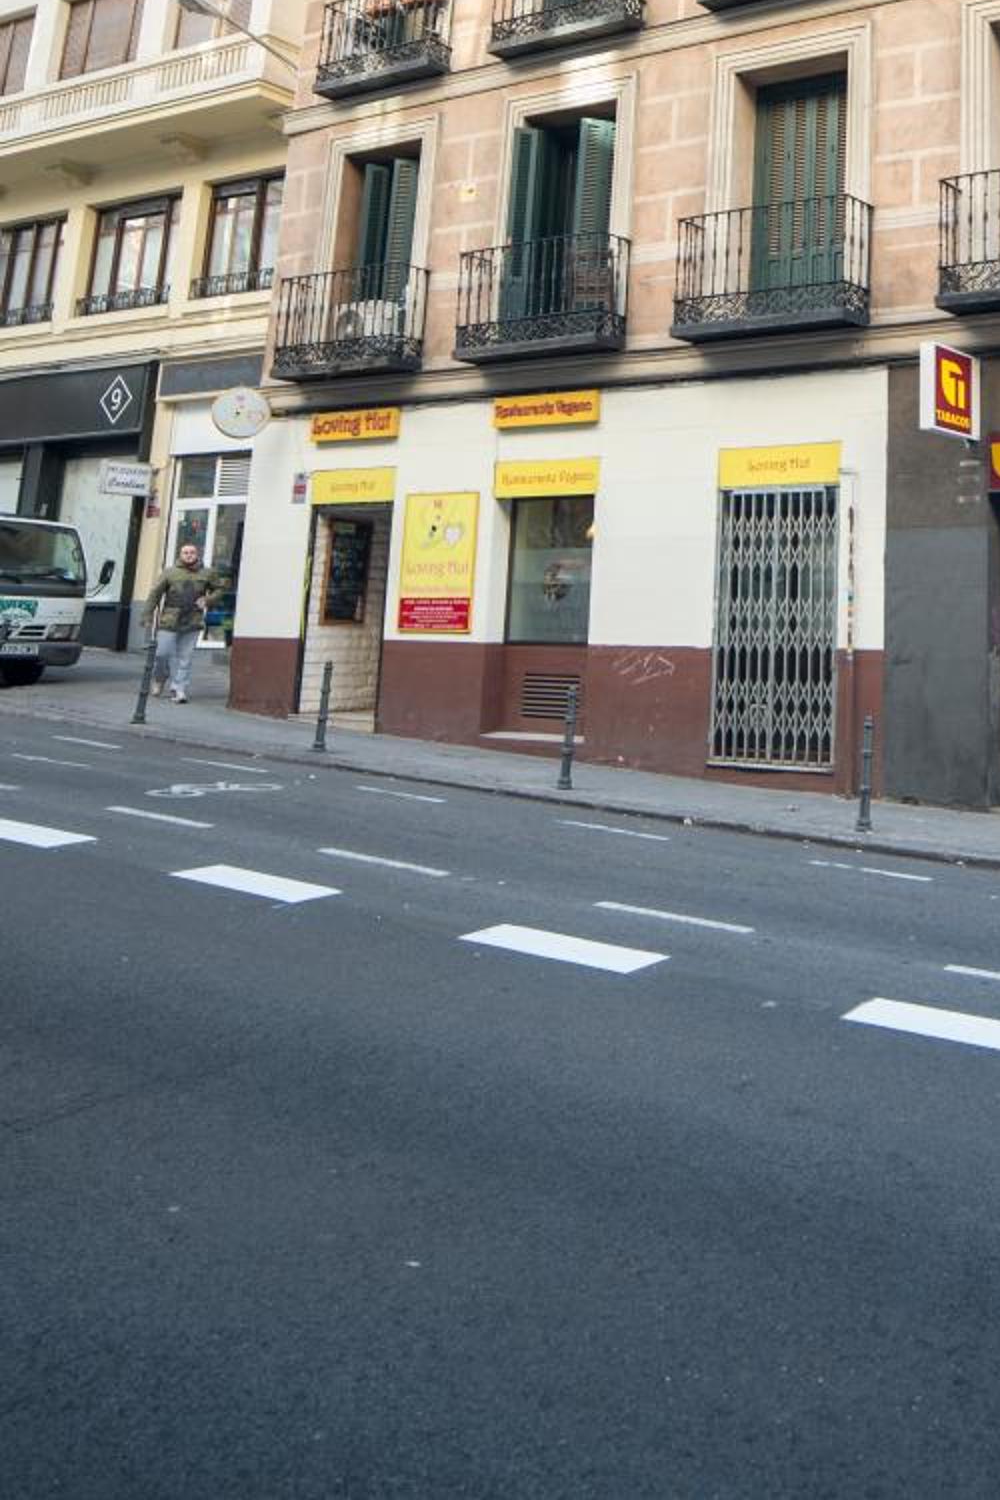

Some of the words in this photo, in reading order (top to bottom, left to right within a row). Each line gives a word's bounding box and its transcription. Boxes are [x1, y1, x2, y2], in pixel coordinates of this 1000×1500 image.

[110, 387, 122, 411] 9
[312, 415, 361, 436] Loving
[936, 408, 971, 429] TABACOS
